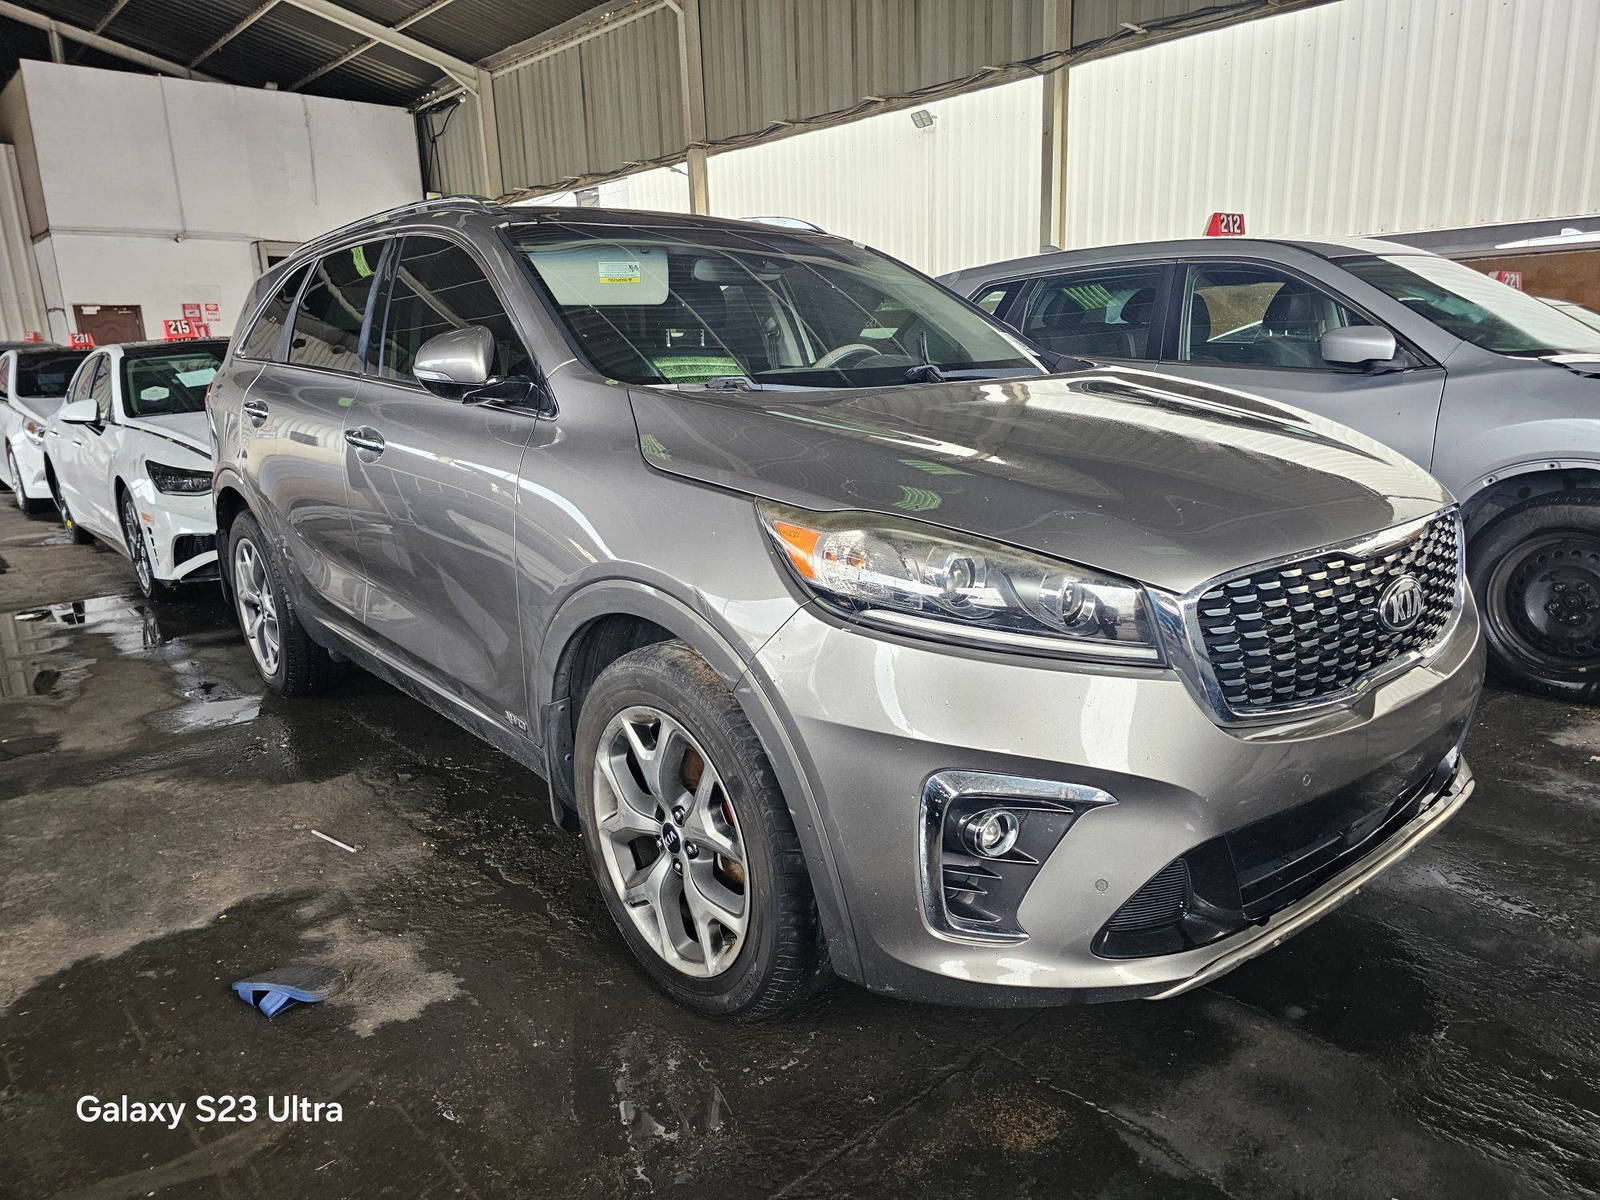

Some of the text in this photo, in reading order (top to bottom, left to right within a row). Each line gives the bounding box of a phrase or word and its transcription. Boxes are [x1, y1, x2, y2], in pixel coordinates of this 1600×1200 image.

[1220, 214, 1241, 233] 212
[168, 320, 191, 335] 215
[74, 333, 89, 344] 231
[1391, 588, 1421, 623] KIA
[664, 830, 678, 847] KIA
